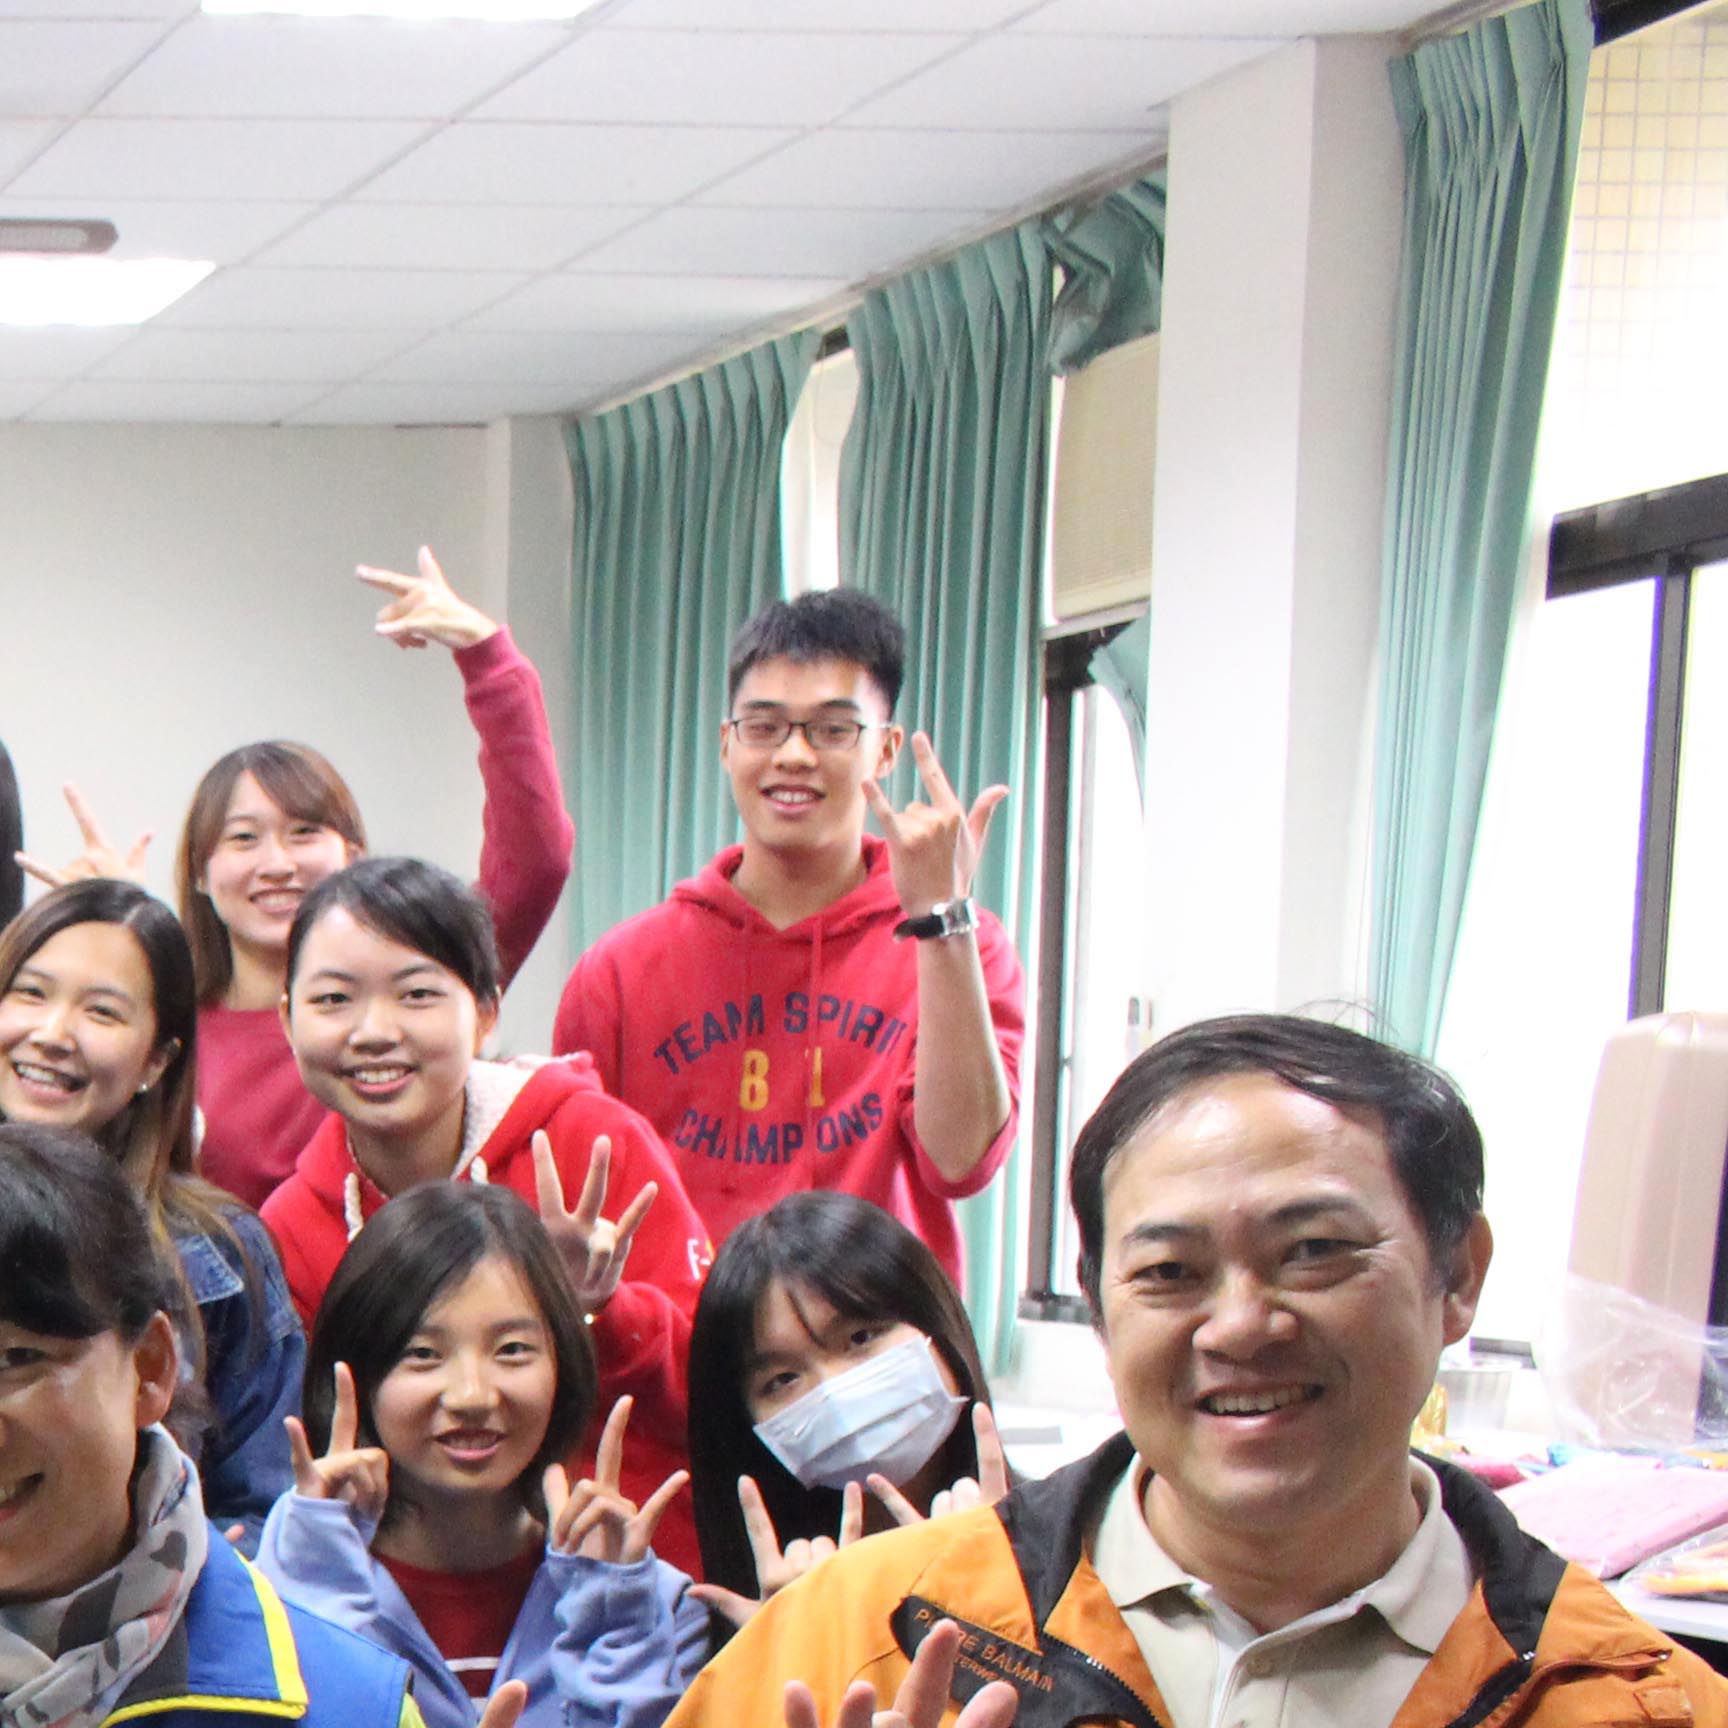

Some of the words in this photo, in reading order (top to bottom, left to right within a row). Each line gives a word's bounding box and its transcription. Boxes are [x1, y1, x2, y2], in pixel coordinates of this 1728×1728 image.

[653, 993, 765, 1076] TEAM
[675, 1092, 884, 1165] CHAMPONS
[913, 1608, 980, 1650] PIRE
[981, 1643, 1055, 1693] BALMAIN
